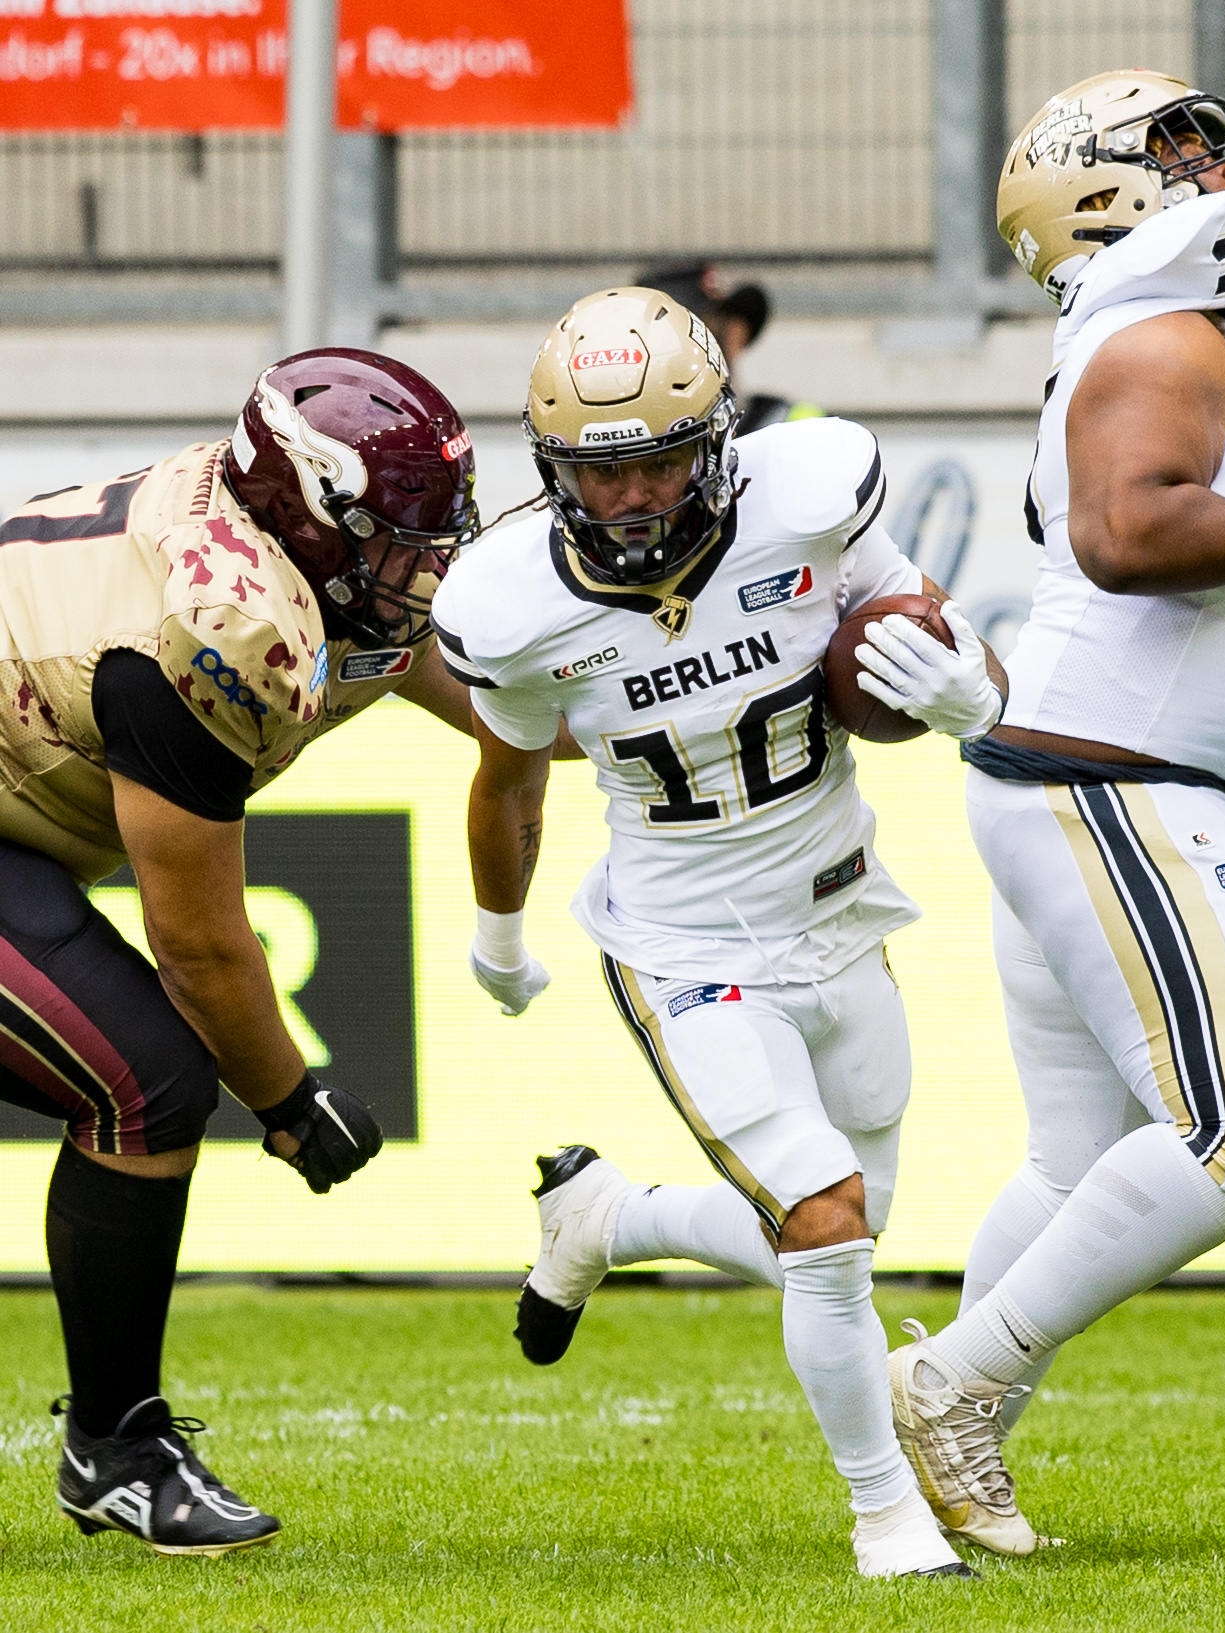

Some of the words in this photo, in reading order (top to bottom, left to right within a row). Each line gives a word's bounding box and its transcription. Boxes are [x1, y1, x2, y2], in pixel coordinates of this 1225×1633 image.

[206, 28, 251, 77] in
[578, 349, 637, 369] GAZI
[584, 427, 644, 442] FORELLE
[743, 578, 780, 595] EUROPEAN
[745, 589, 771, 603] LEAGUE
[747, 593, 783, 609] FOOTBALL
[623, 631, 780, 711] BERLIN
[602, 661, 833, 827] 10
